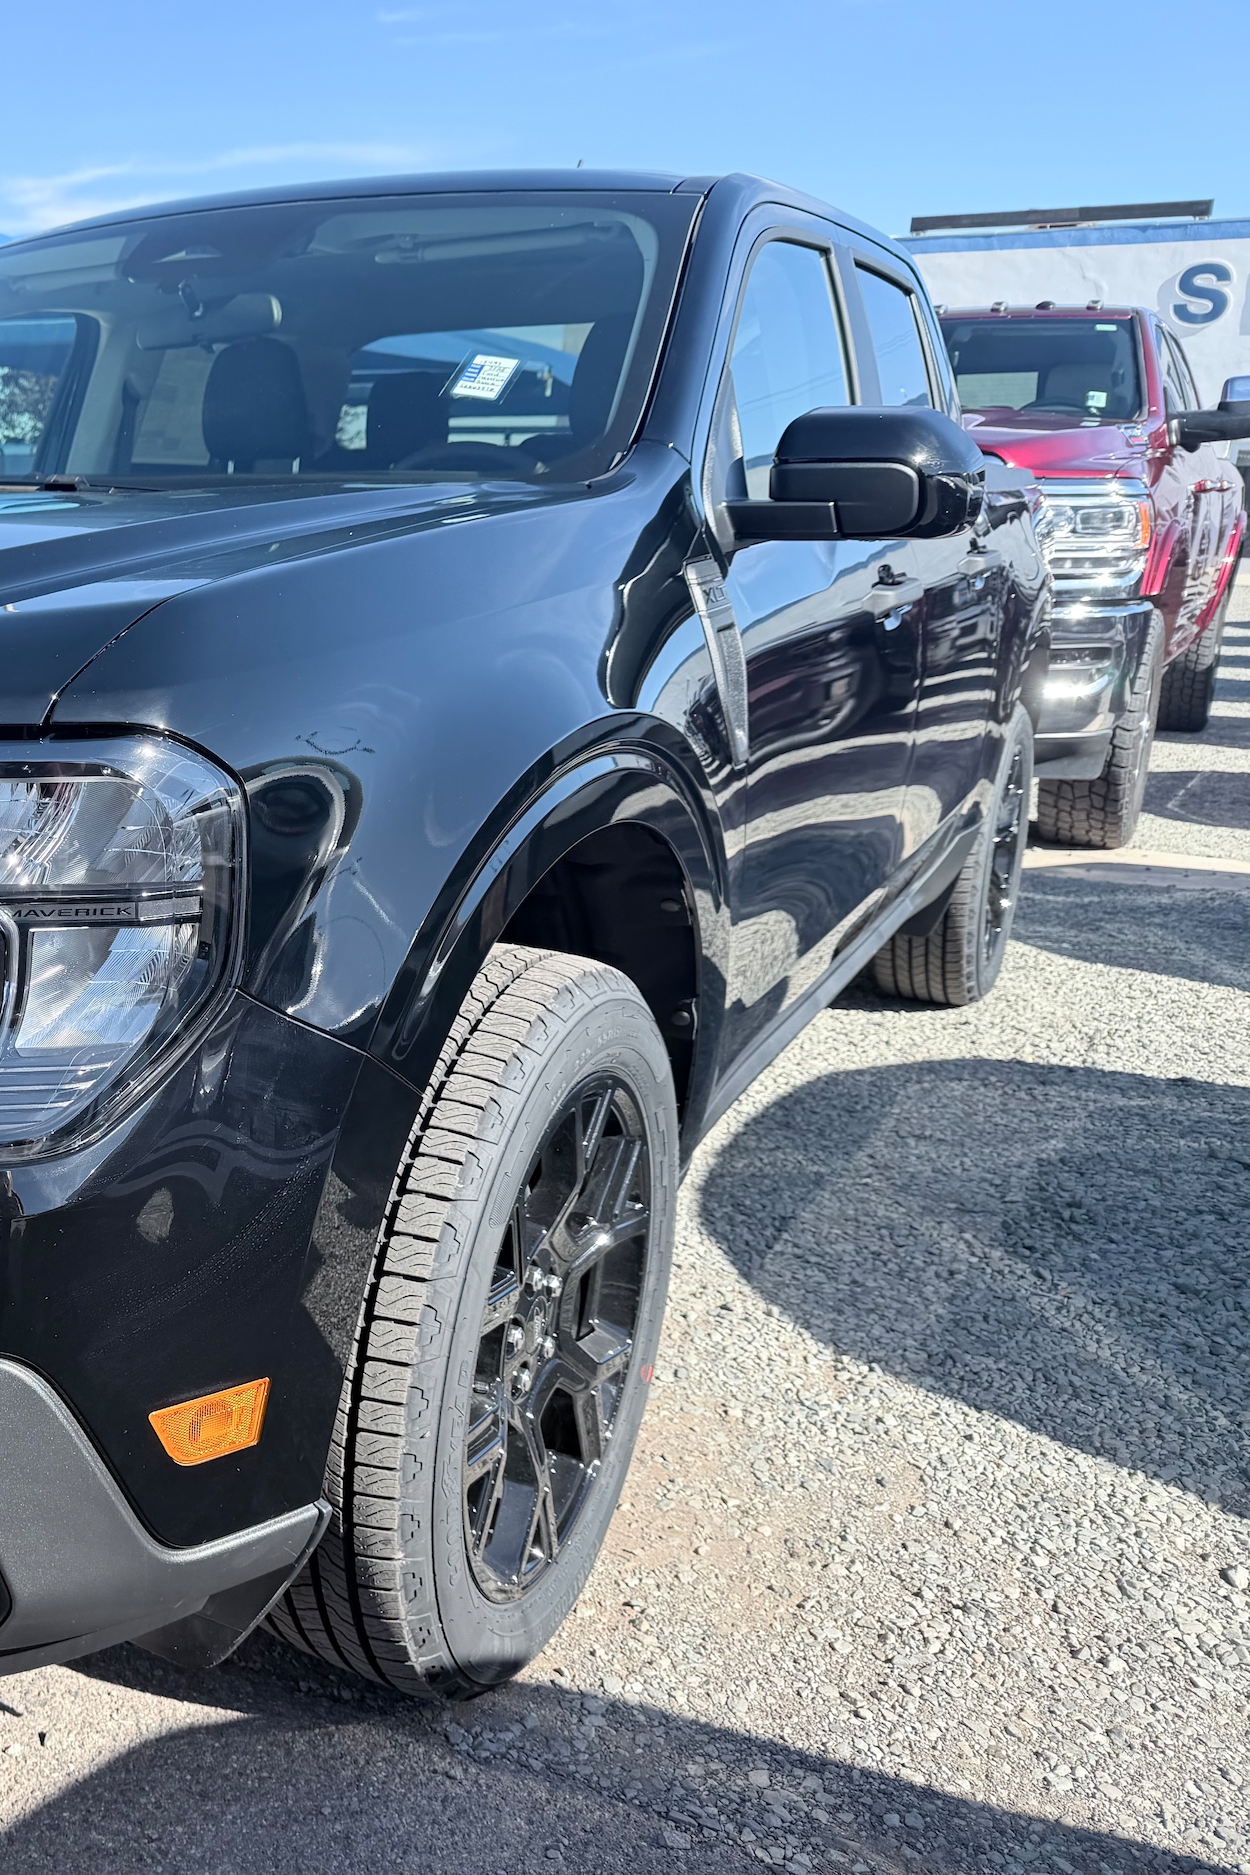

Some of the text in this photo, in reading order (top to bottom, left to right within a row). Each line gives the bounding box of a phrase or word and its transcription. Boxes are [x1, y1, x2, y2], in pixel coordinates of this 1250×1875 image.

[702, 585, 727, 605] XLT
[10, 905, 133, 919] MAVERICK
[438, 1358, 471, 1588] GOODYEAR
